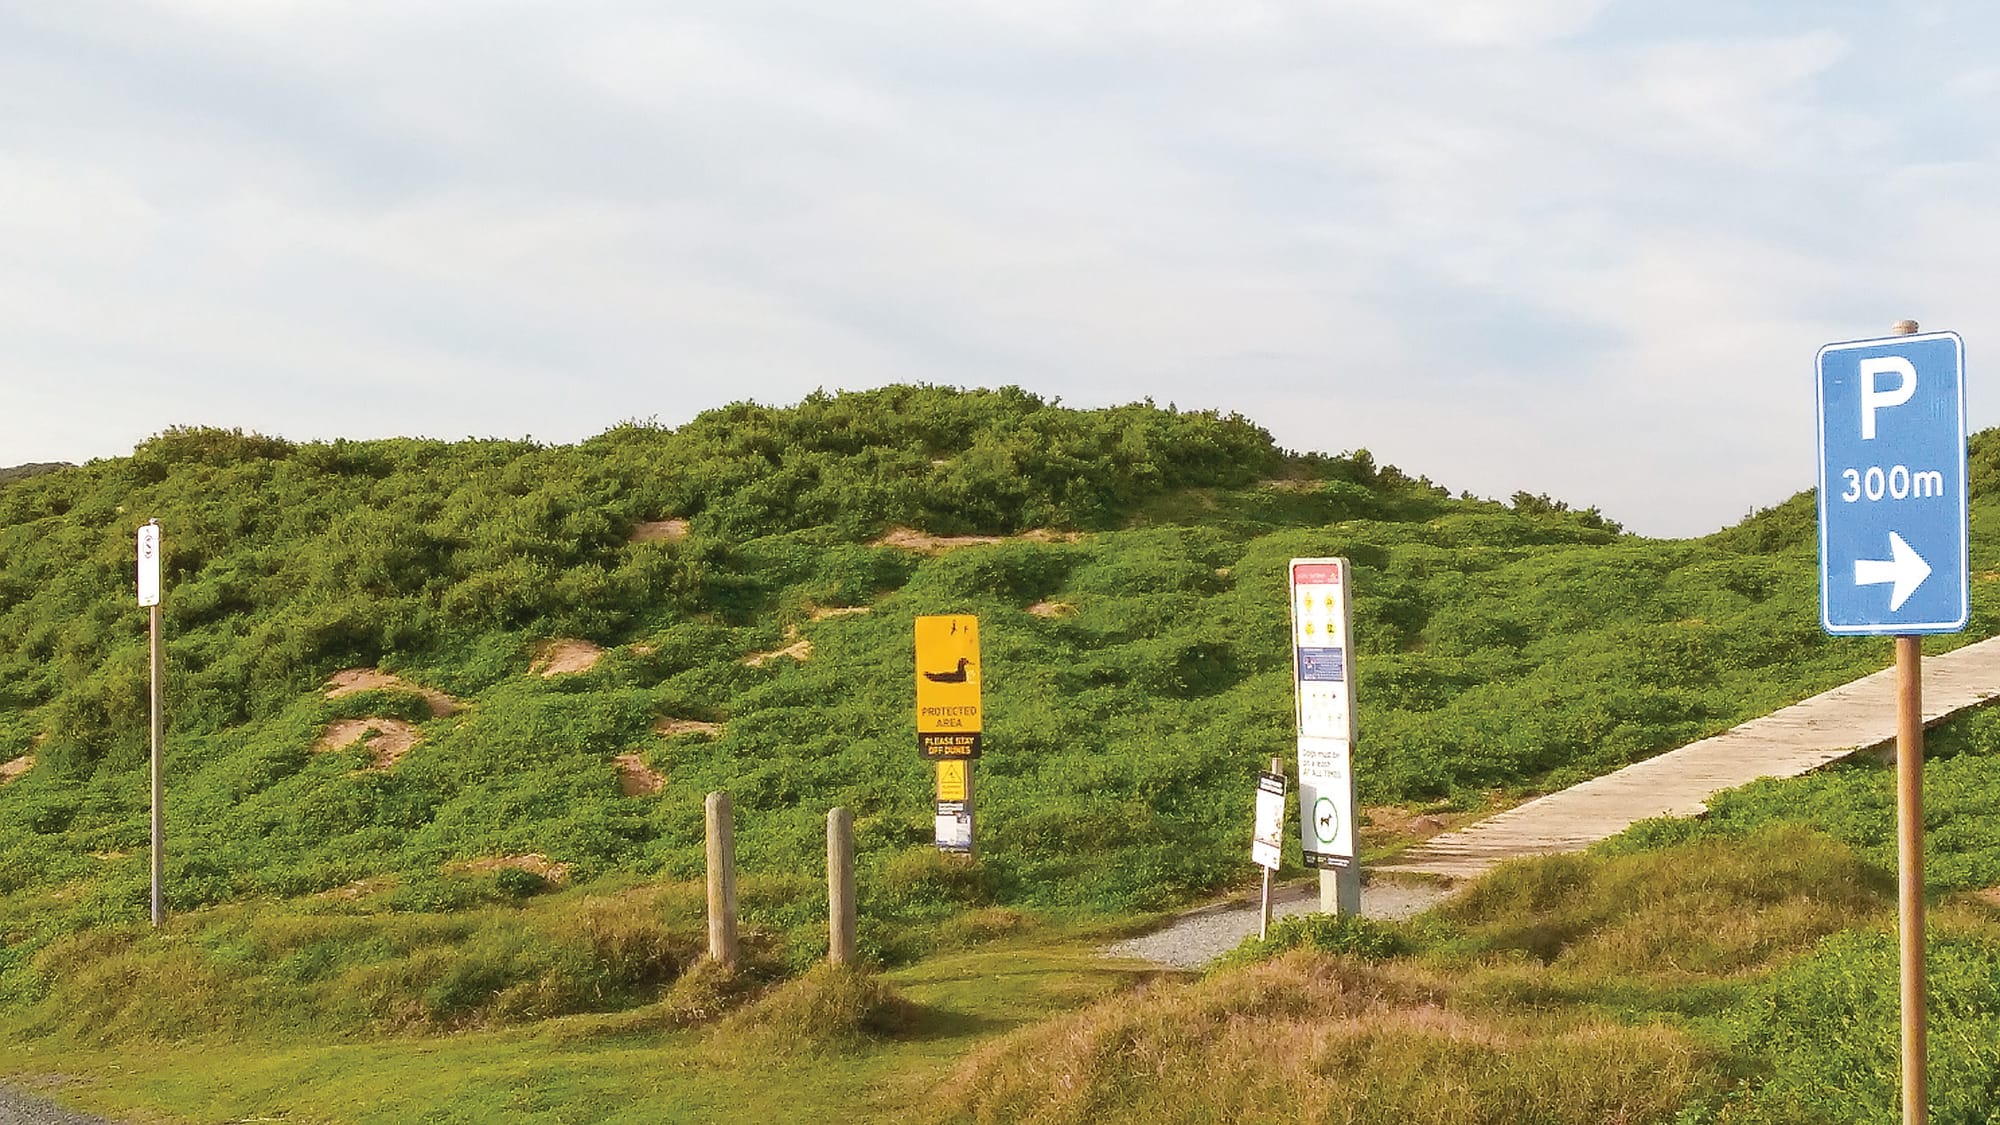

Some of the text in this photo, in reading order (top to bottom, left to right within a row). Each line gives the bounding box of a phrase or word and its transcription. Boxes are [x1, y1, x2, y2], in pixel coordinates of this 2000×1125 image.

[1859, 355, 1918, 440] P
[1841, 464, 1944, 503] 300m
[921, 706, 977, 716] PROTECTED
[936, 719, 963, 727] AREA
[925, 737, 975, 745] PLEASE STAY
[928, 746, 971, 755] OFF DUNES
